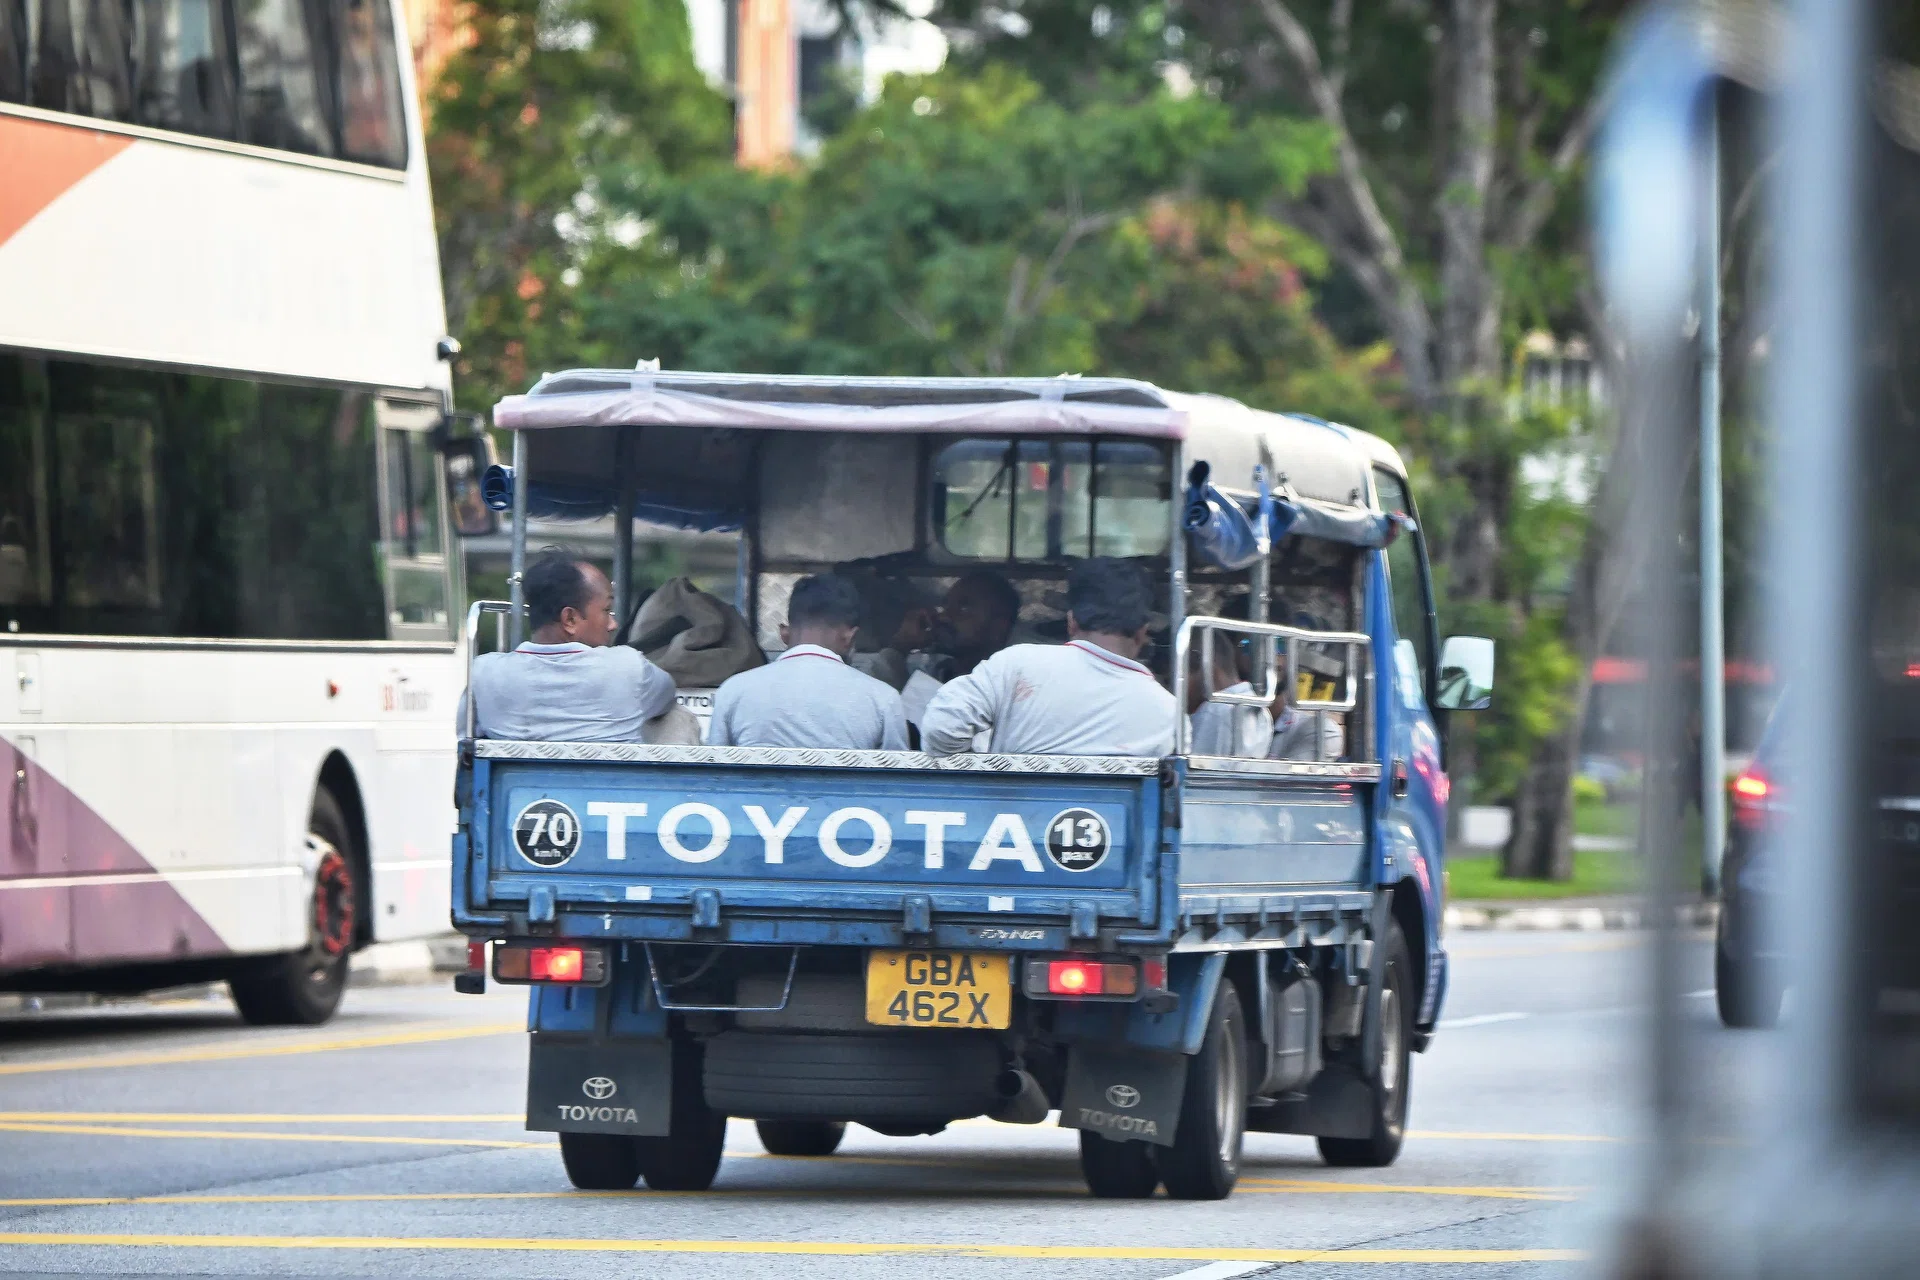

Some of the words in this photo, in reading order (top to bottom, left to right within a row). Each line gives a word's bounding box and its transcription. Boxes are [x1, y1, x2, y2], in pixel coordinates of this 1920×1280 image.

[524, 812, 572, 847] 70
[587, 801, 1045, 873] TOYOTA
[1054, 817, 1102, 848] 13
[533, 848, 562, 858] km/h
[1061, 851, 1094, 864] pax
[905, 953, 976, 987] GBA
[888, 990, 990, 1025] 462X
[557, 1105, 638, 1123] TOYOTA
[1078, 1107, 1158, 1136] TOYOTA
